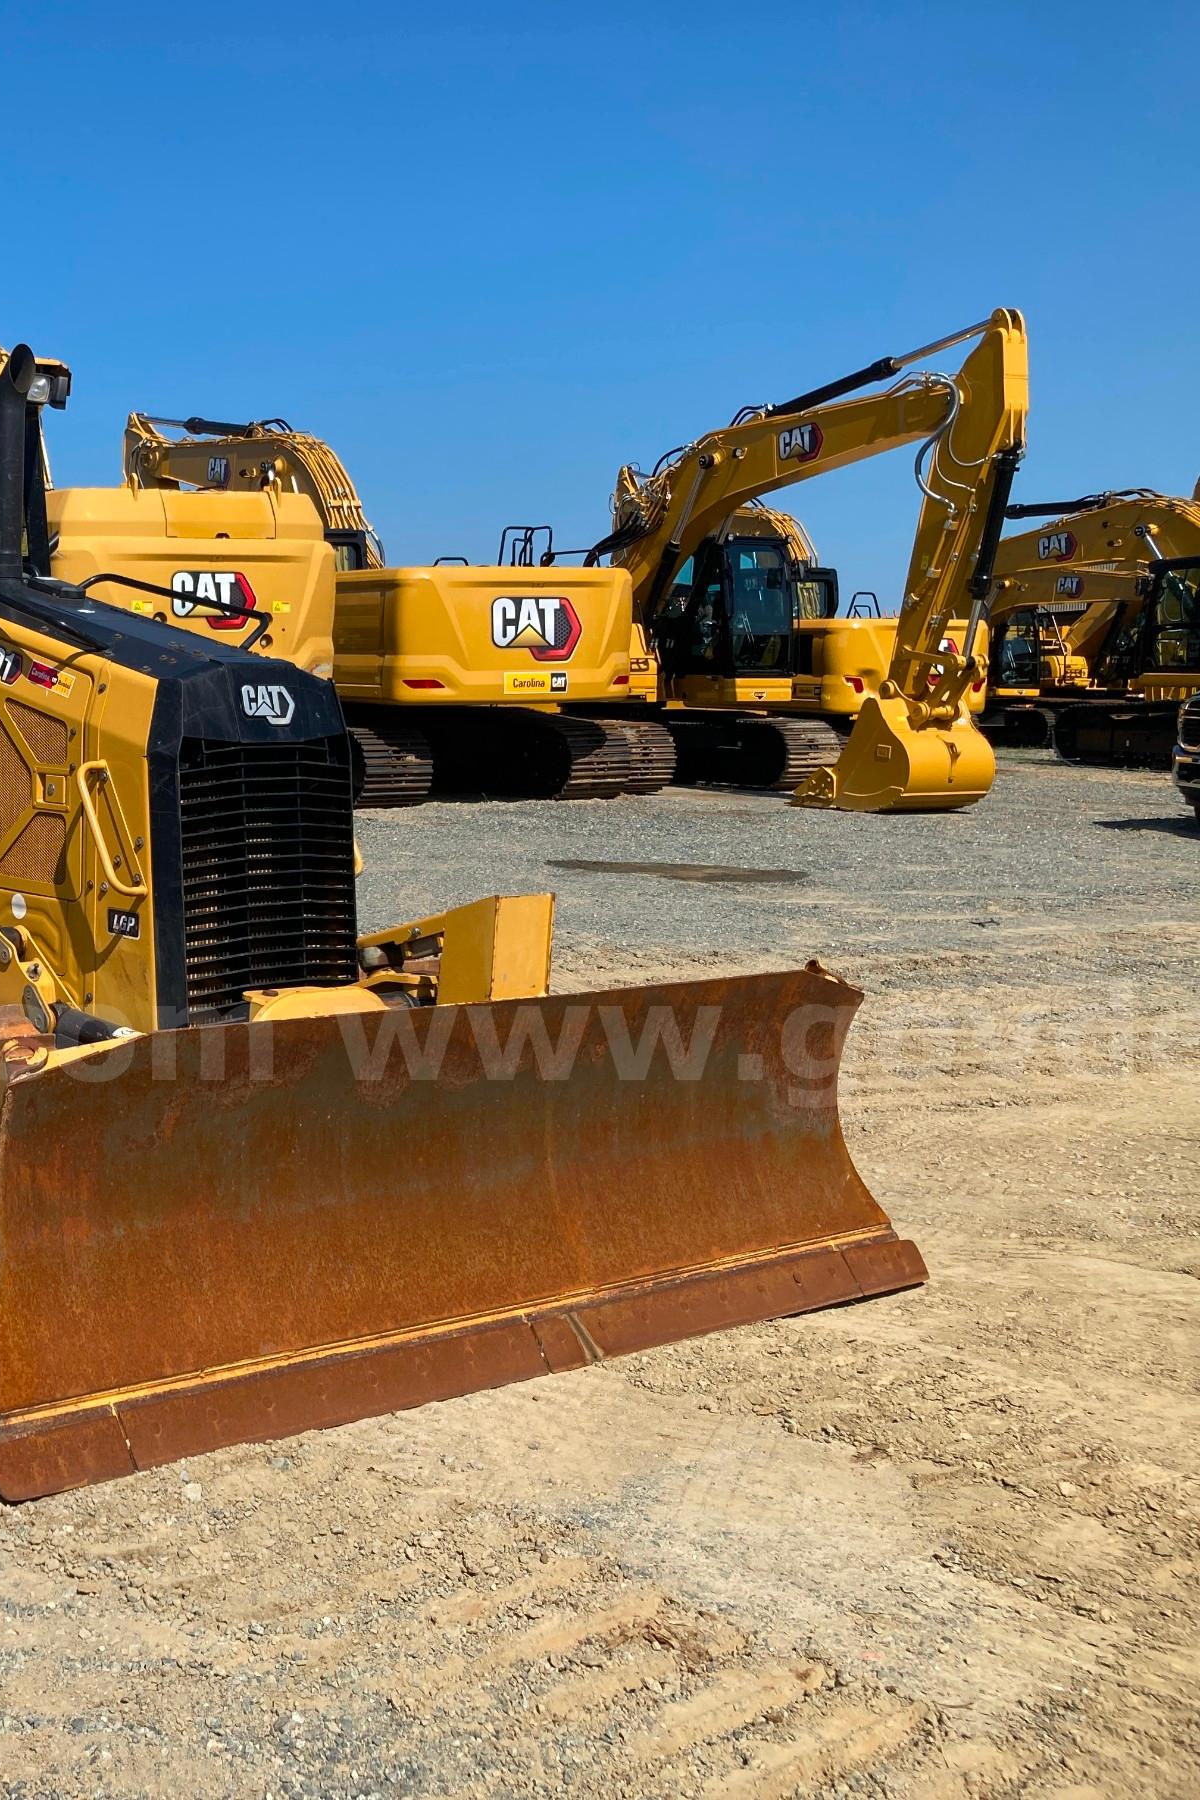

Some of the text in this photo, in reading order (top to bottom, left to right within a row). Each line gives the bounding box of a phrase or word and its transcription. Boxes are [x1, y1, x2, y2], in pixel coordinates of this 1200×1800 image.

[779, 424, 812, 459] CAT
[208, 458, 227, 482] CAT
[1039, 533, 1068, 560] CAT
[172, 572, 236, 617] CAT
[1057, 577, 1080, 594] CAT
[492, 598, 560, 648] CAT
[513, 677, 566, 688] Carolina CAT
[241, 684, 281, 716] CAT
[112, 914, 136, 932] LGP
